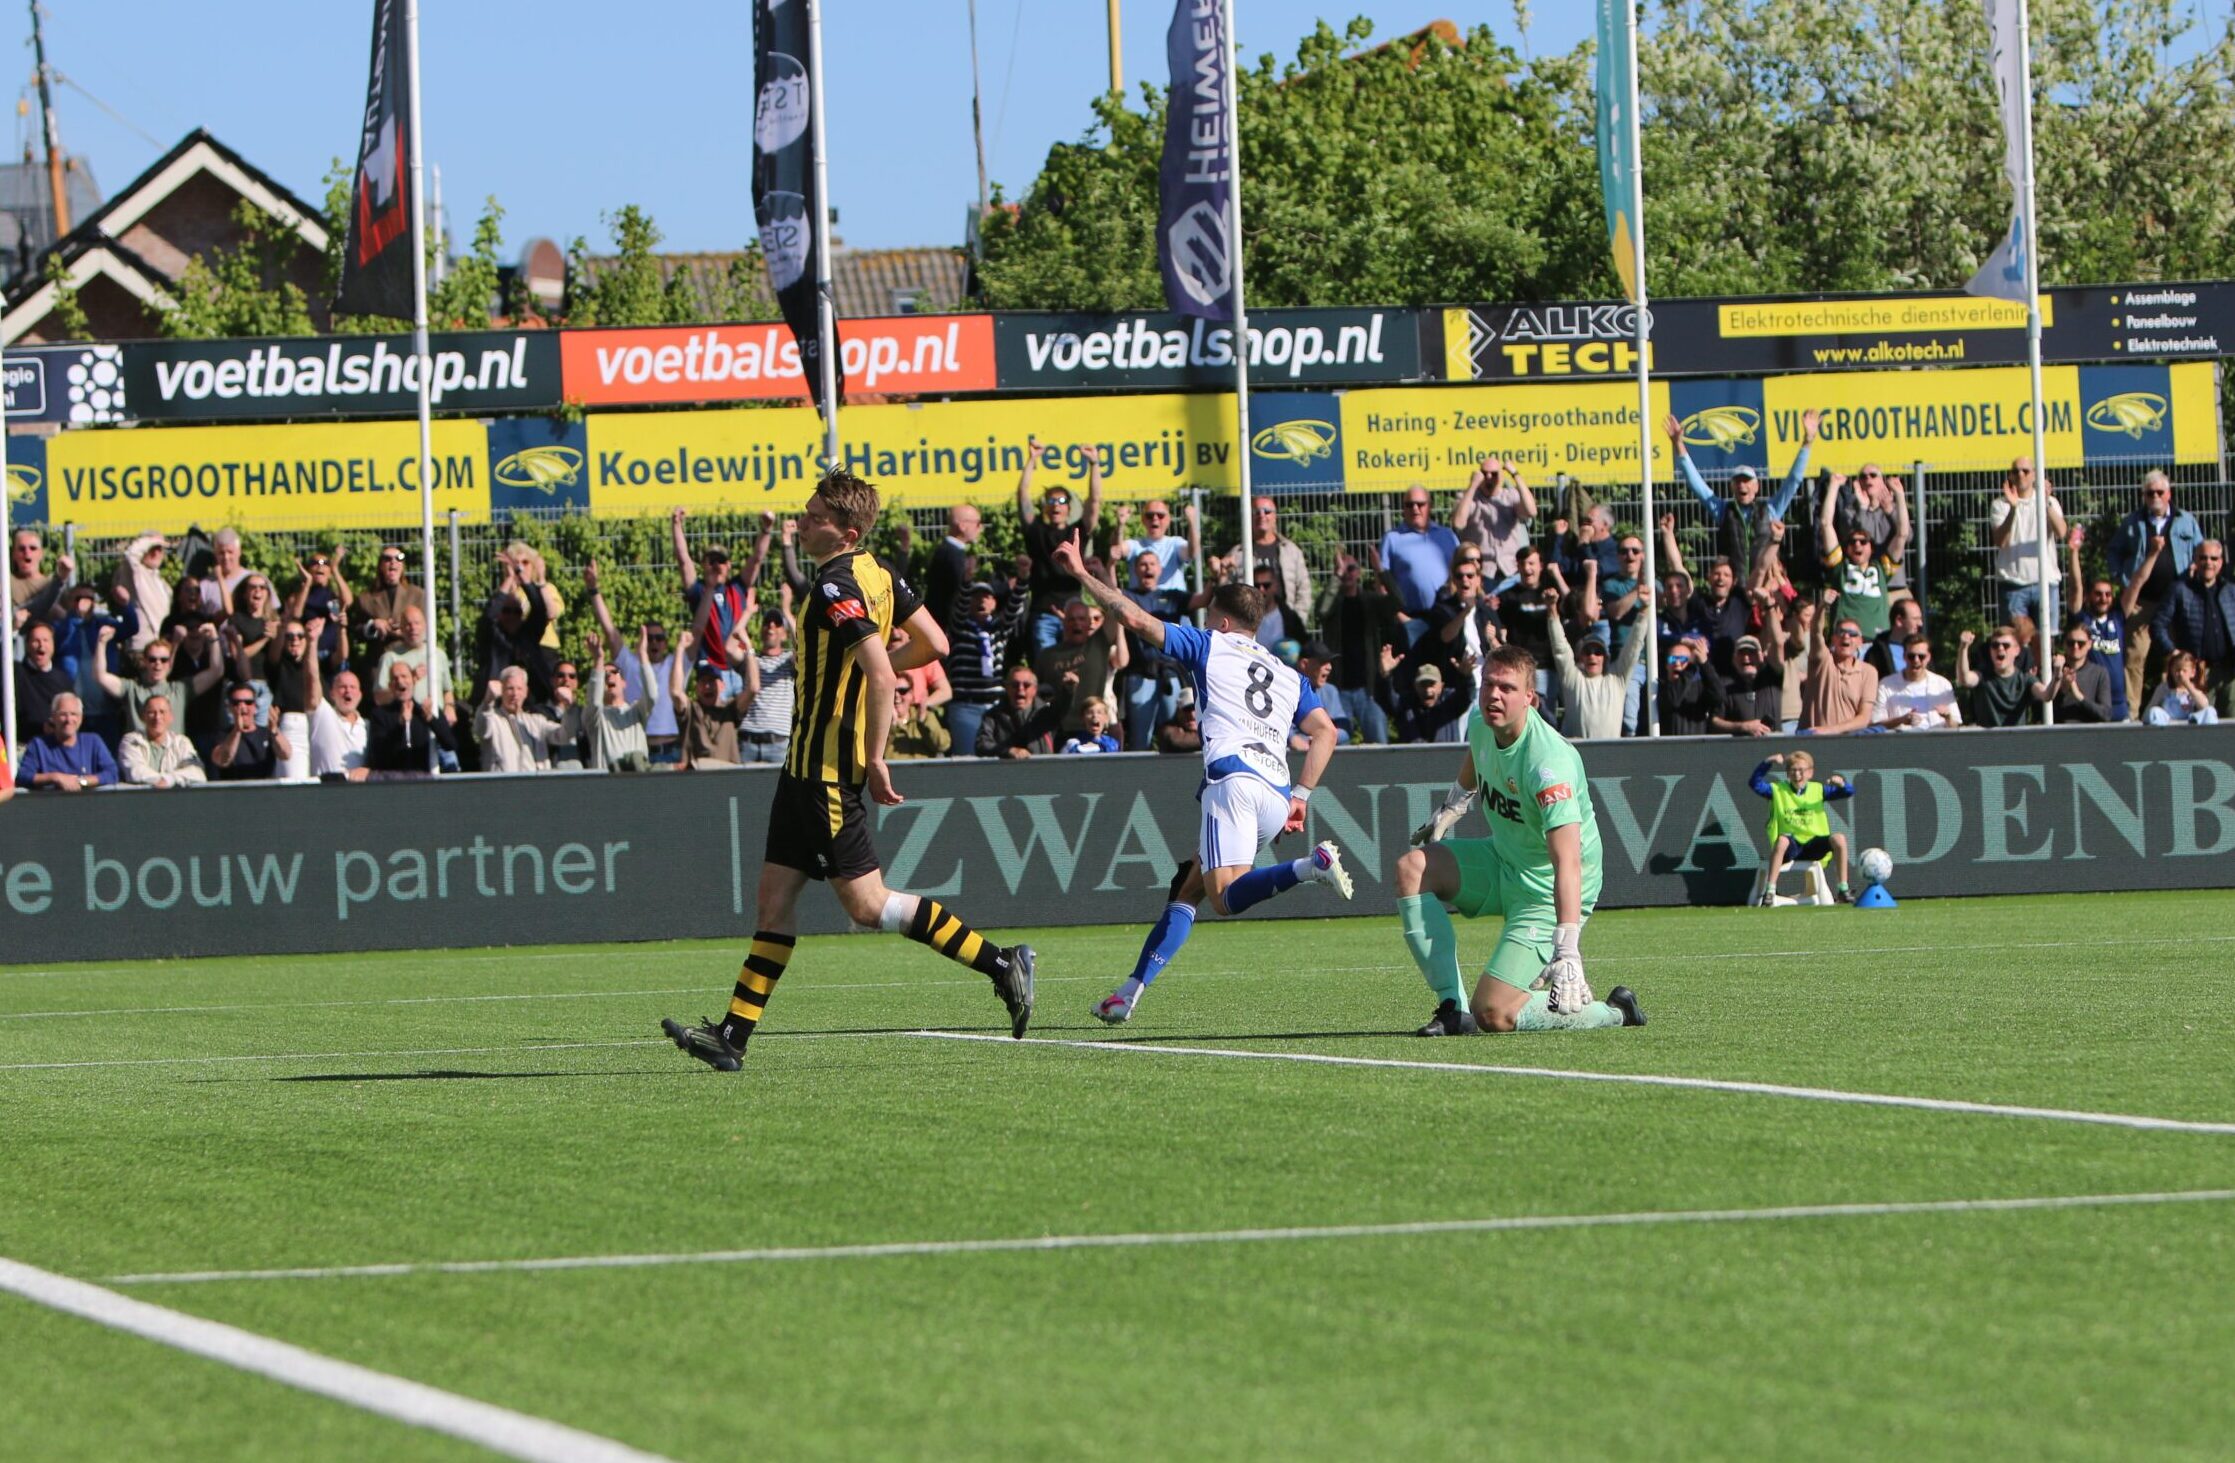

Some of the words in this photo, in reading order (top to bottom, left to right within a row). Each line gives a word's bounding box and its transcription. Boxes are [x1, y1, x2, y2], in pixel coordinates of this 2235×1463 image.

[2124, 289, 2197, 307] Assemblage
[1501, 305, 1655, 341] ALKO
[1730, 305, 1892, 331] Elektrotechnische
[1901, 302, 2030, 324] dienstverlenin
[2126, 313, 2197, 329] Paneelbouw
[596, 322, 960, 388] voetbalsop.nl
[1026, 313, 1385, 378] voetbalshop.nl
[1502, 341, 1654, 376] TECH
[1813, 338, 1964, 363] www.alkotech.nl
[2127, 335, 2218, 353] Elektrotechniek
[156, 337, 528, 404] voetbalshop.nl
[1367, 412, 1436, 436] Haring
[1454, 405, 1641, 433] Zeevisgroothande
[1773, 401, 2073, 442] VIGROOTHANDEL.CM
[1197, 443, 1230, 466] BV
[1357, 447, 1429, 472] Rokerij
[1566, 440, 1661, 466] Diepvris
[63, 455, 475, 502] VISGROOTHANDEL.COM
[1844, 563, 1882, 598] 52
[1245, 661, 1274, 719] 8
[0, 861, 53, 915] e
[84, 843, 304, 911] bouw
[335, 834, 630, 921] partner
